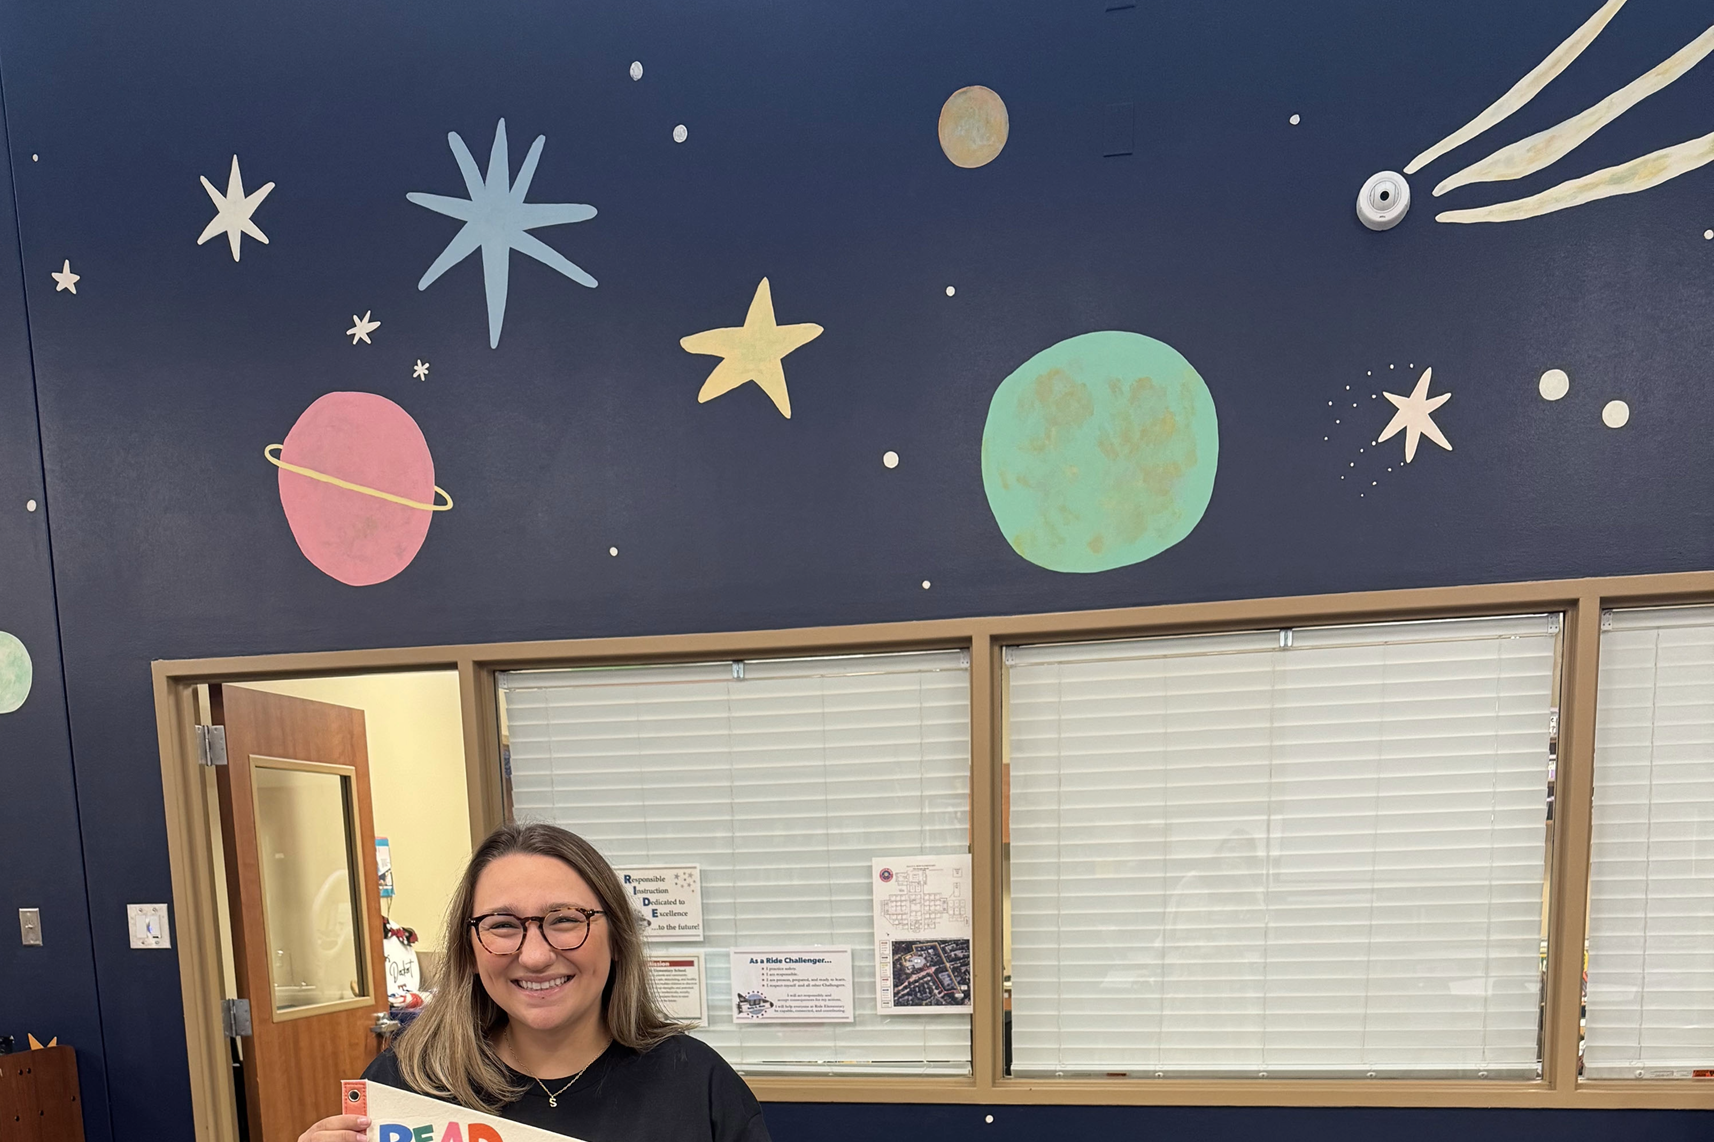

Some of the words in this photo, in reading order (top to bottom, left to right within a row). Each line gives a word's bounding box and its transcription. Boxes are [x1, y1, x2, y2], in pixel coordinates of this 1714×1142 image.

[624, 874, 666, 884] Responsible
[633, 886, 669, 895] Instruction
[642, 897, 677, 906] Dedicated
[652, 908, 688, 918] Excellence
